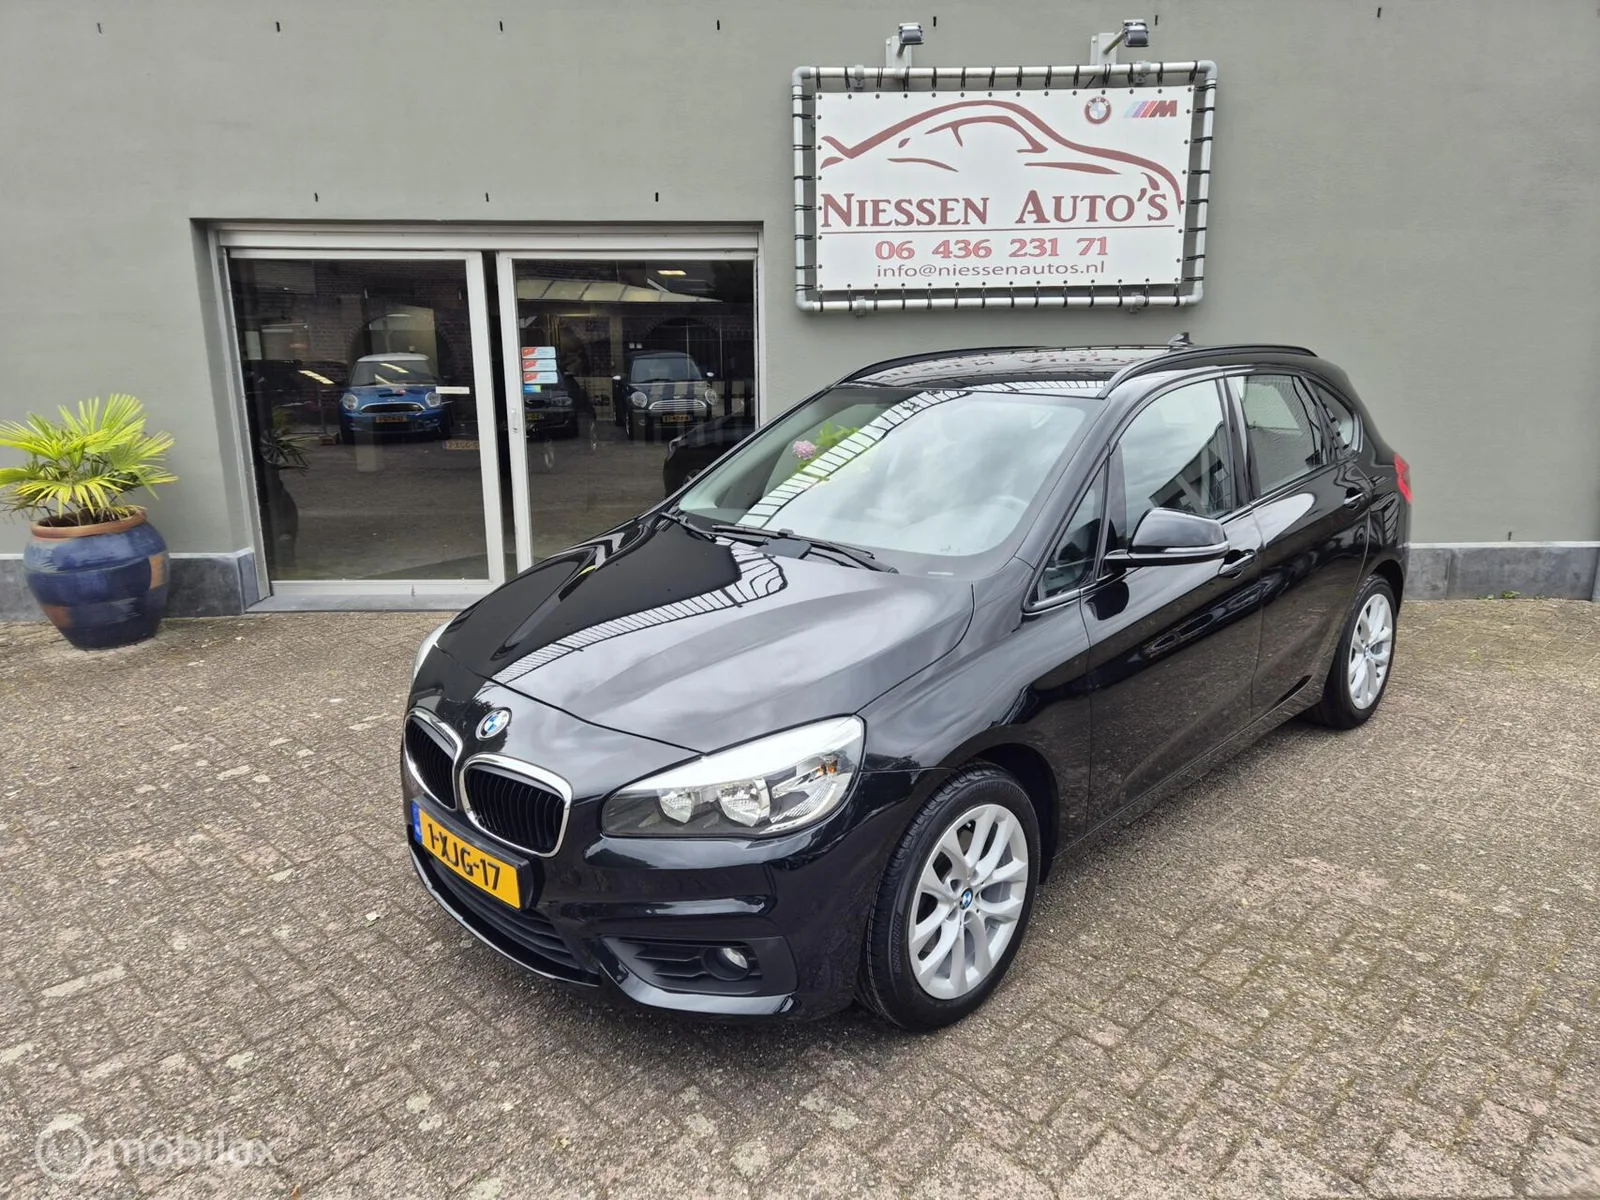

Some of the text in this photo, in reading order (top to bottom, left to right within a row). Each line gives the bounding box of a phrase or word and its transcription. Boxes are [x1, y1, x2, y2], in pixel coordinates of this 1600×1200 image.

[820, 187, 1168, 228] NIESSEN AUTO'S
[875, 236, 1109, 260] 06 436 231 71
[876, 260, 1106, 278] info@niessenautos.nl
[427, 822, 501, 892] 1-XJG-17
